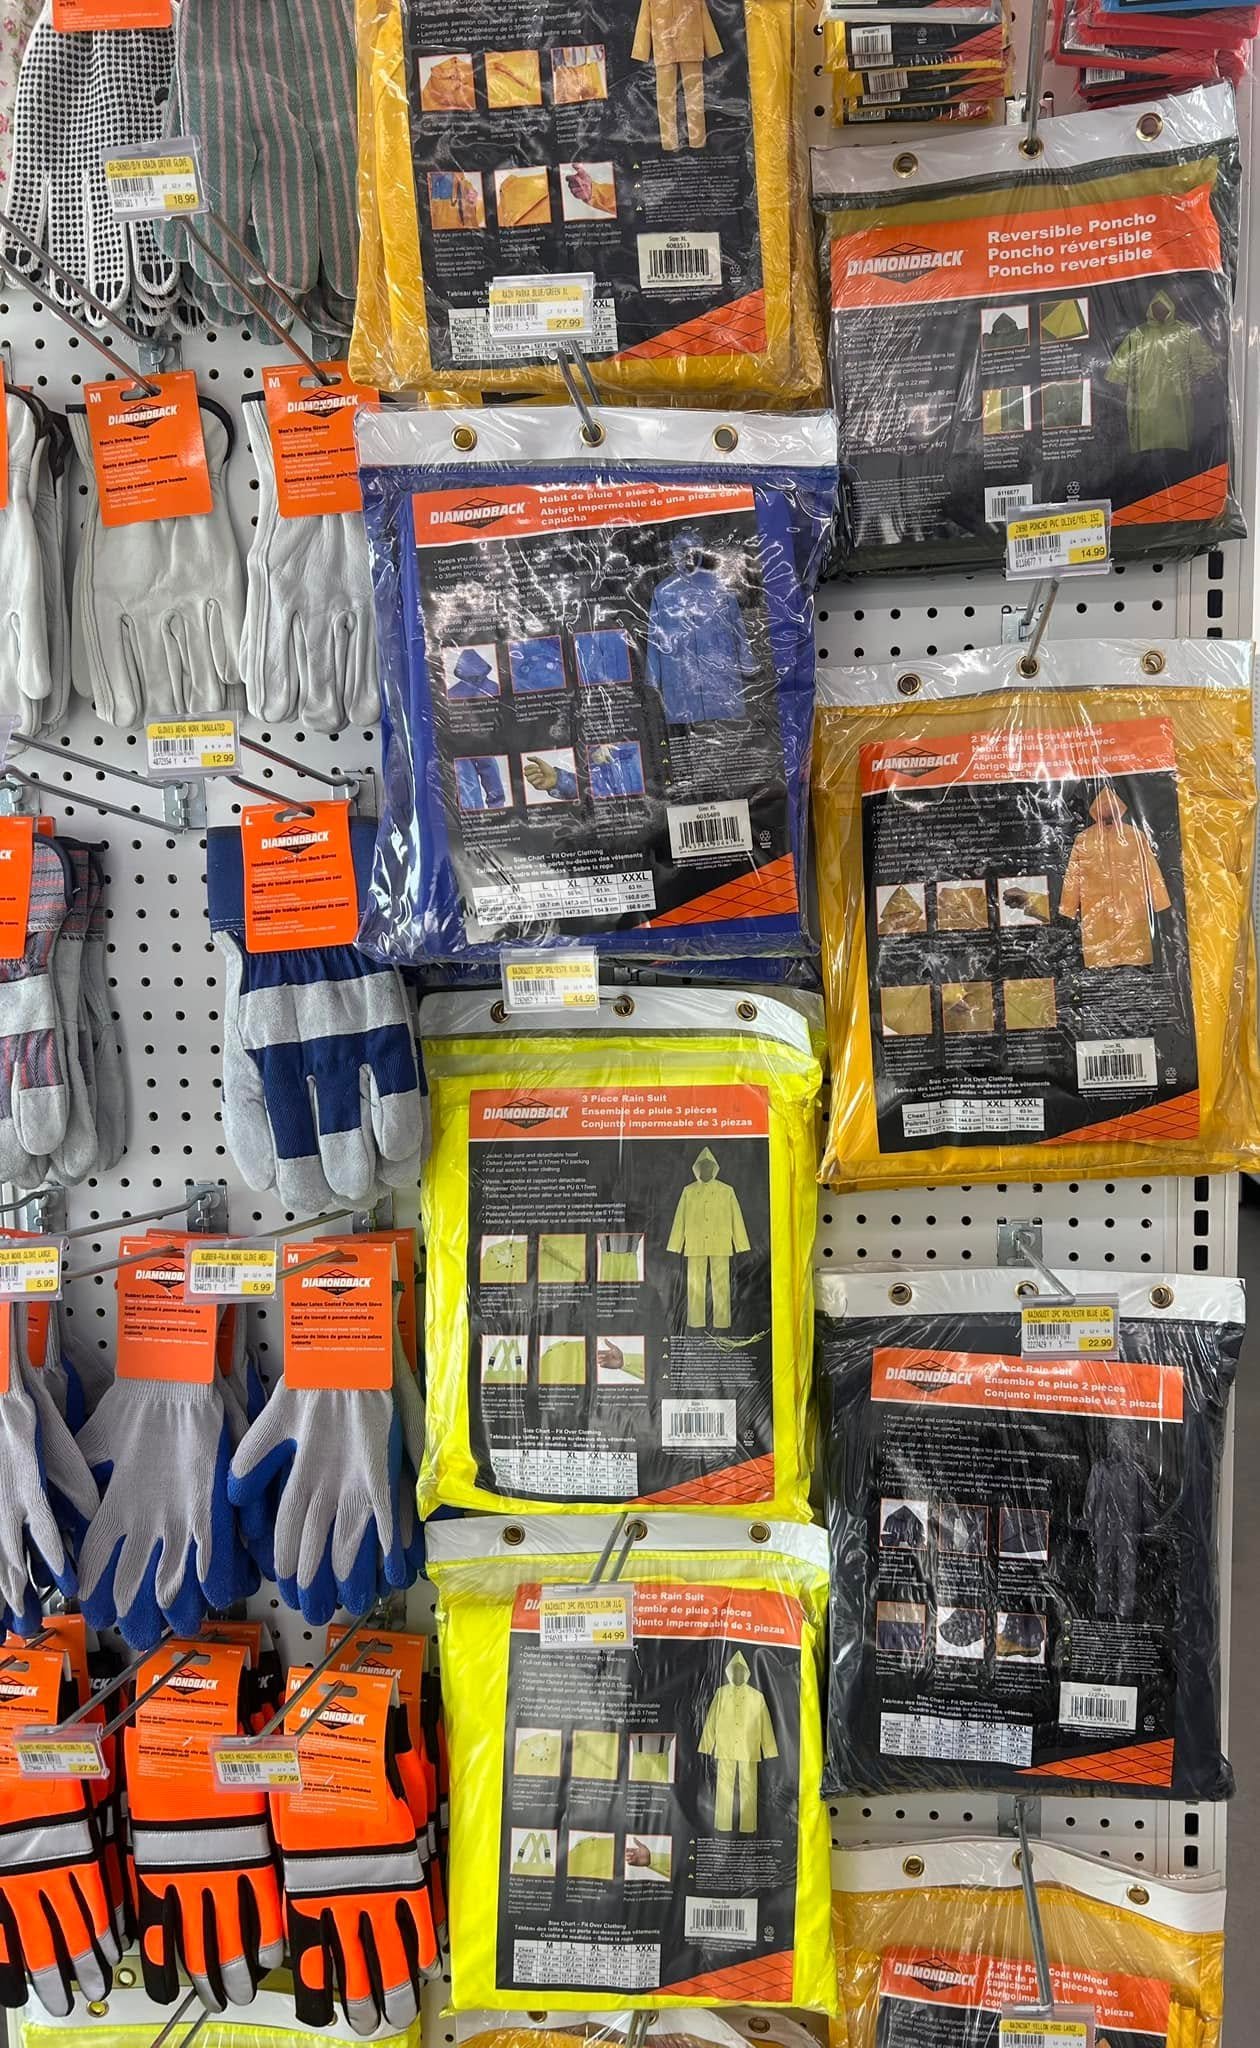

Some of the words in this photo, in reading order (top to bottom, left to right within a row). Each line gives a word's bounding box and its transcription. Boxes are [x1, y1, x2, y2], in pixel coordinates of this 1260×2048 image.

[172, 194, 196, 204] 18.99
[988, 224, 1082, 244] Reversible
[1089, 213, 1157, 233] Poncho
[988, 244, 1054, 261] Poncho
[1060, 230, 1153, 254] réversible
[846, 250, 964, 277] DIAMONDBACK
[988, 262, 1055, 278] Poncho
[1060, 247, 1153, 272] reversible
[556, 319, 581, 329] 27.99
[268, 377, 281, 388] M
[89, 392, 102, 404] M
[287, 395, 359, 413] DIAMONDBACK
[108, 404, 178, 426] DIAMONDBACK
[539, 495, 568, 505] Habit
[570, 492, 584, 501] de
[587, 490, 613, 501] pluie
[540, 505, 575, 517] Abrigo
[577, 499, 648, 512] impermeable
[650, 499, 663, 507] de
[666, 495, 685, 504] una
[430, 502, 526, 525] DIAMONDBACK
[541, 514, 587, 526] capucha
[1081, 546, 1105, 559] 14.99
[212, 754, 234, 763] 12.99
[871, 753, 960, 773] DIAMONDBACK
[973, 760, 1005, 771] Abrigo
[245, 816, 253, 826] L
[261, 831, 329, 849] DIAMONDBACK
[528, 854, 545, 862] Chart
[577, 848, 604, 858] Clothing
[572, 865, 592, 873] Sobre
[567, 879, 580, 888] XL
[592, 876, 613, 885] XXL
[621, 873, 649, 883] XXXL
[573, 994, 596, 1003] 44.99
[582, 1094, 588, 1103] 3
[591, 1094, 619, 1103] Piece
[622, 1094, 645, 1102] Rain
[647, 1094, 668, 1102] Suit
[962, 1100, 975, 1108] XL
[986, 1100, 1006, 1108] XXL
[1014, 1099, 1040, 1107] XXXL
[482, 1106, 570, 1121] DIAMONDBACK
[581, 1107, 631, 1116] Ensemble
[633, 1106, 646, 1115] de
[648, 1106, 673, 1117] pluie
[675, 1106, 682, 1115] 3
[684, 1106, 718, 1116] pièces
[581, 1119, 627, 1130] Conjunto
[629, 1118, 695, 1129] impermeable
[696, 1118, 709, 1127] de
[711, 1118, 719, 1127] 3
[720, 1118, 753, 1128] piezas
[122, 1244, 131, 1256] L
[287, 1253, 299, 1264] M
[36, 1279, 54, 1288] 5.99
[253, 1283, 271, 1292] 5.99
[302, 1277, 371, 1288] DIAMONDBACK
[1088, 1338, 1112, 1348] 22.99
[885, 1366, 973, 1386] DIAMONDBACK
[984, 1376, 1035, 1387] Ensemble
[1037, 1379, 1051, 1388] de
[1053, 1380, 1079, 1391] pluie
[1081, 1381, 1089, 1390] 2
[984, 1388, 1031, 1400] Conjunto
[1033, 1391, 1101, 1405] impermeable
[1119, 1397, 1127, 1406] 2
[1129, 1398, 1163, 1409] piezas
[522, 1449, 530, 1457] M
[567, 1451, 578, 1459] XL
[587, 1452, 605, 1460] XXL
[611, 1453, 634, 1461] XXXL
[660, 1591, 682, 1601] Rain
[685, 1592, 705, 1601] Suit
[670, 1606, 683, 1614] de
[685, 1606, 710, 1616] pluie
[711, 1606, 718, 1615] 3
[666, 1618, 729, 1629] impermeable
[730, 1622, 743, 1631] de
[745, 1622, 752, 1631] 3
[753, 1624, 785, 1635] piezas
[601, 1631, 625, 1640] 44.99
[152, 1674, 220, 1691] DMONDBACK
[960, 1720, 972, 1728] XL
[982, 1721, 999, 1729] XXL
[894, 1962, 978, 1987] DIAMONDBACK
[1048, 1968, 1071, 1978] Coat
[1072, 1972, 1109, 1986] W/Hood
[1053, 1980, 1060, 1988] 2
[1062, 1981, 1094, 1994] pièces
[1096, 1988, 1119, 1998] avec
[1095, 2005, 1102, 2013] 2
[1104, 2007, 1134, 2018] piezas
